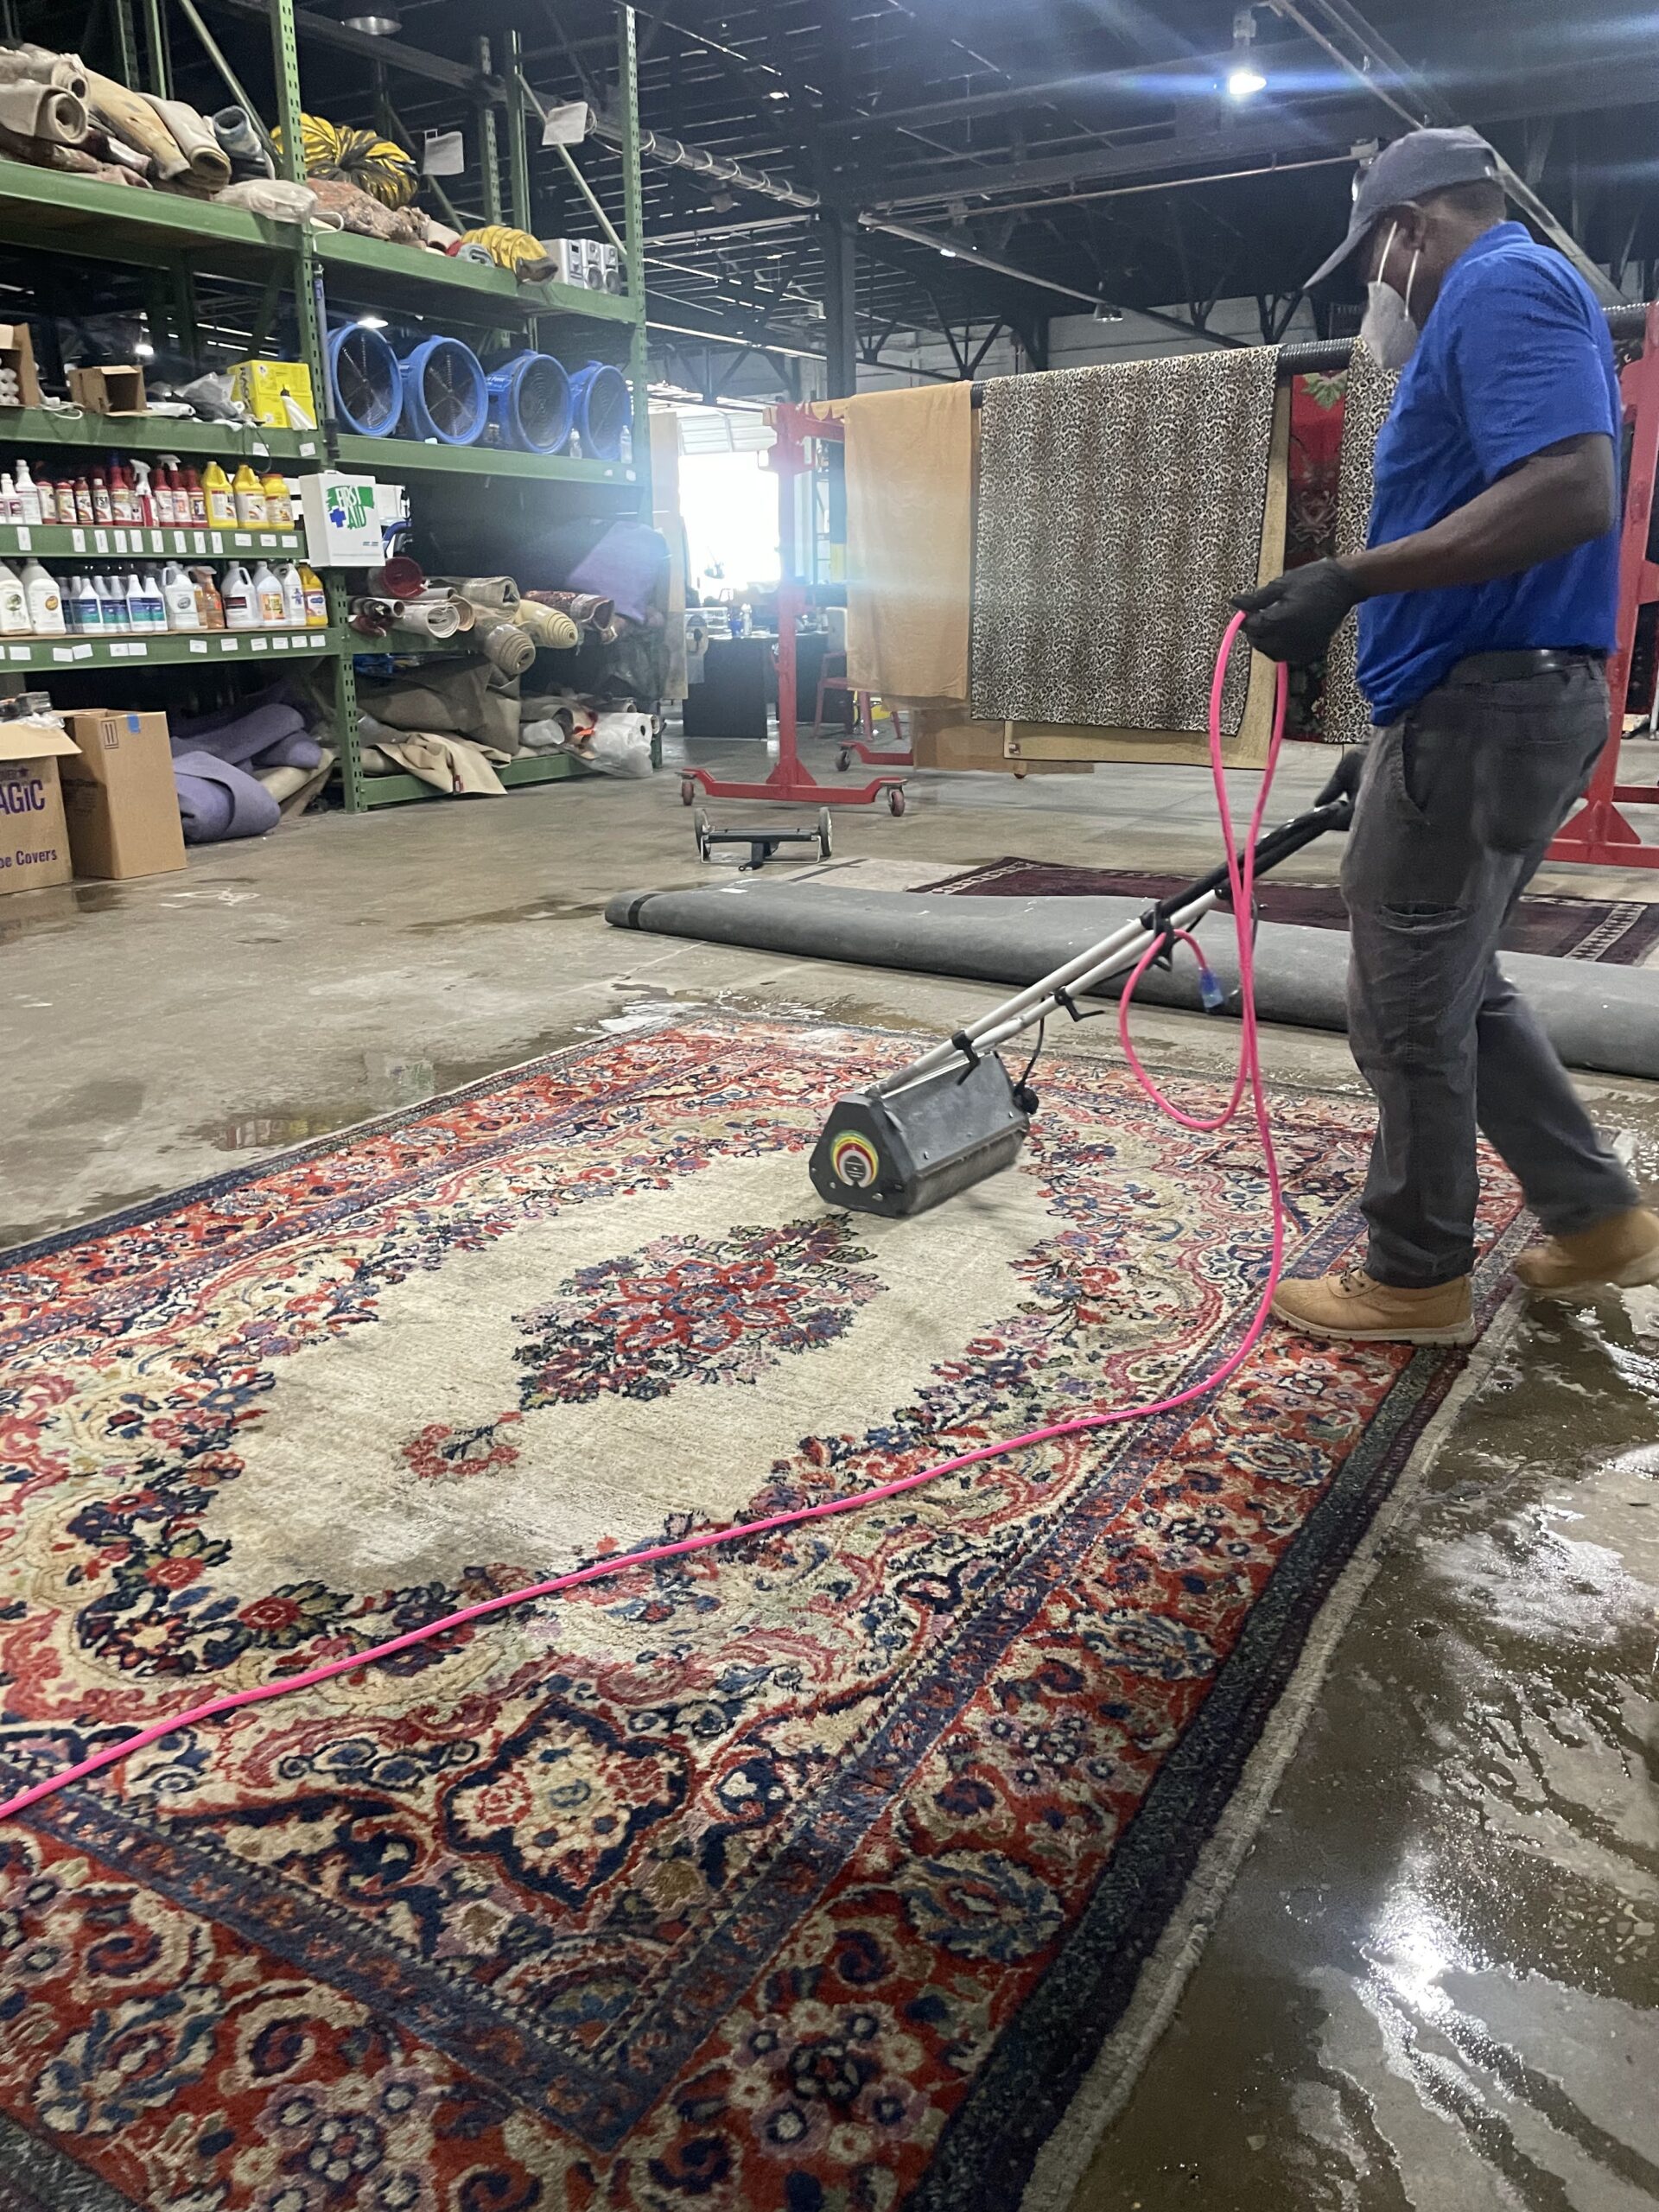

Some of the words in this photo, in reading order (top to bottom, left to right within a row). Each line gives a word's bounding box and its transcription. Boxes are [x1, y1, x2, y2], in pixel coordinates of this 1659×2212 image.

[334, 486, 361, 508] FIRST
[347, 505, 366, 529] AID
[16, 849, 57, 866] Covers
